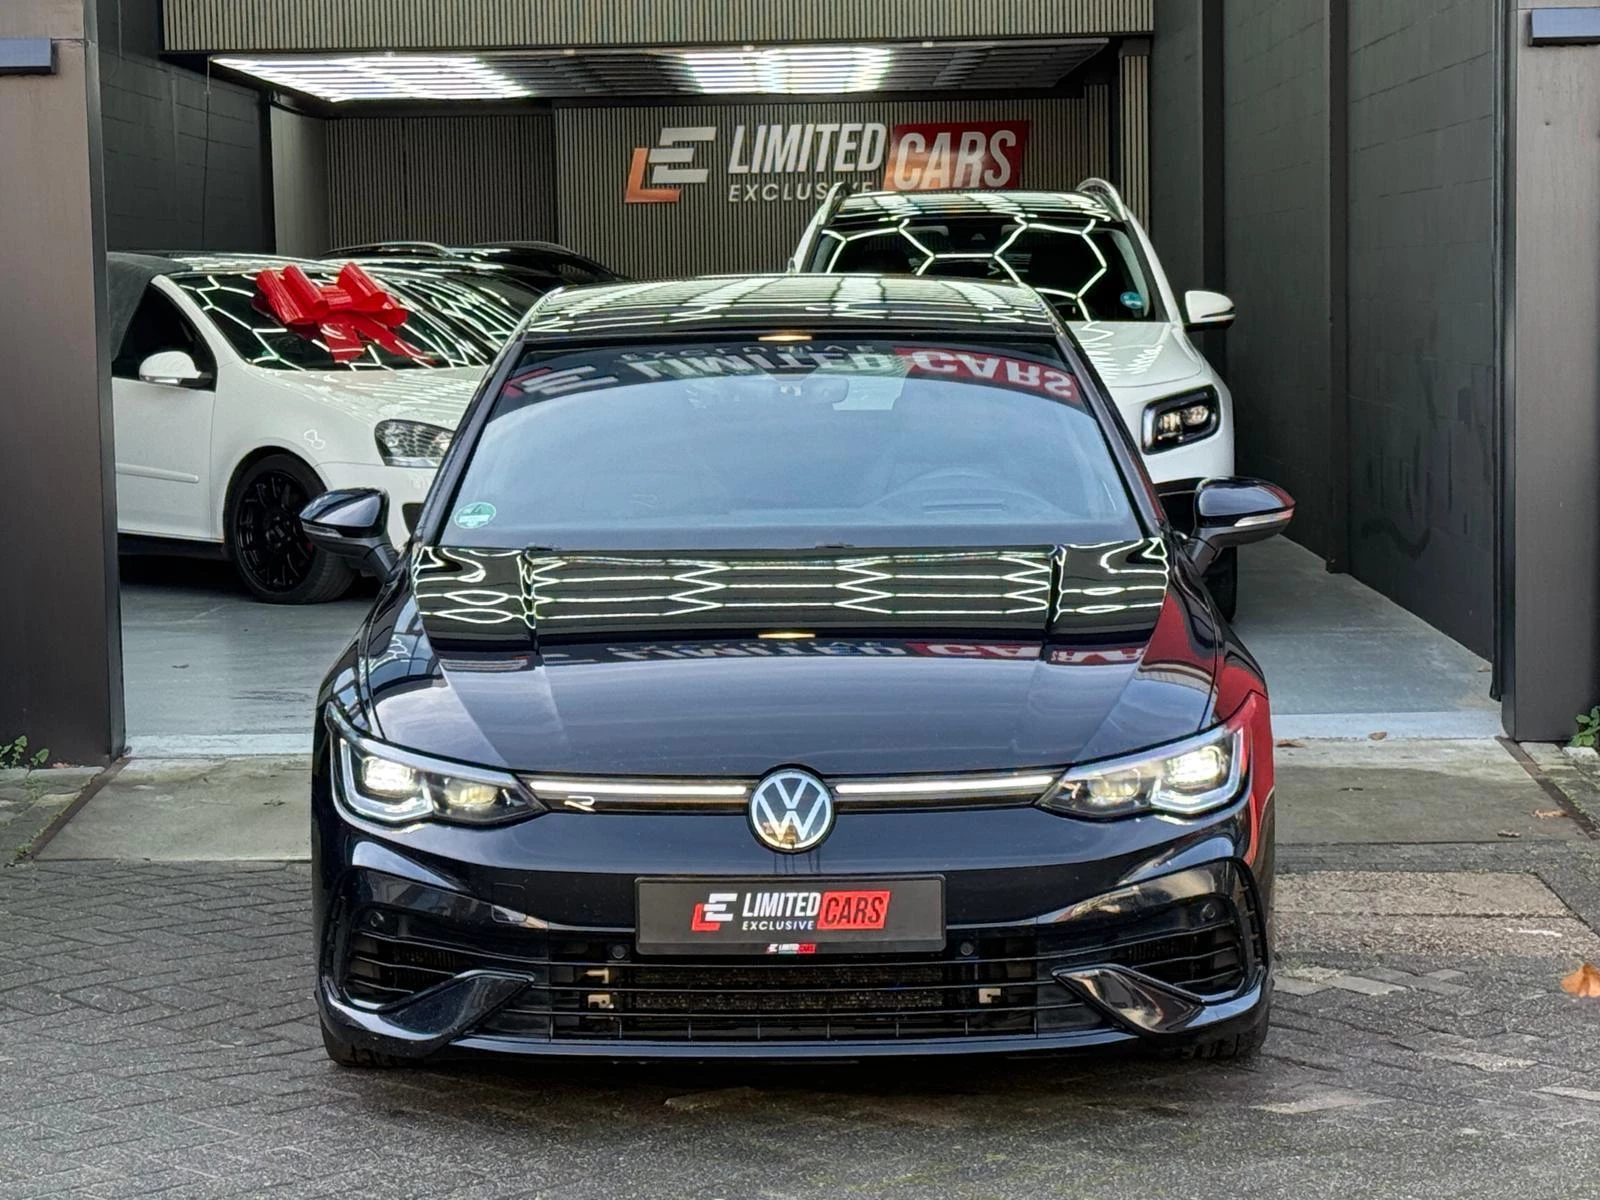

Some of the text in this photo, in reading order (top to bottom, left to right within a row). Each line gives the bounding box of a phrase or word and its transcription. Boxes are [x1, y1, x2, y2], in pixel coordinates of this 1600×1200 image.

[728, 123, 887, 174] LIMITED
[894, 130, 1016, 190] CARS
[728, 181, 873, 202] EXCLUSE
[563, 795, 596, 812] R
[742, 892, 822, 917] LIMITED
[824, 896, 884, 925] CARS
[741, 920, 815, 931] EXCLUSIVE
